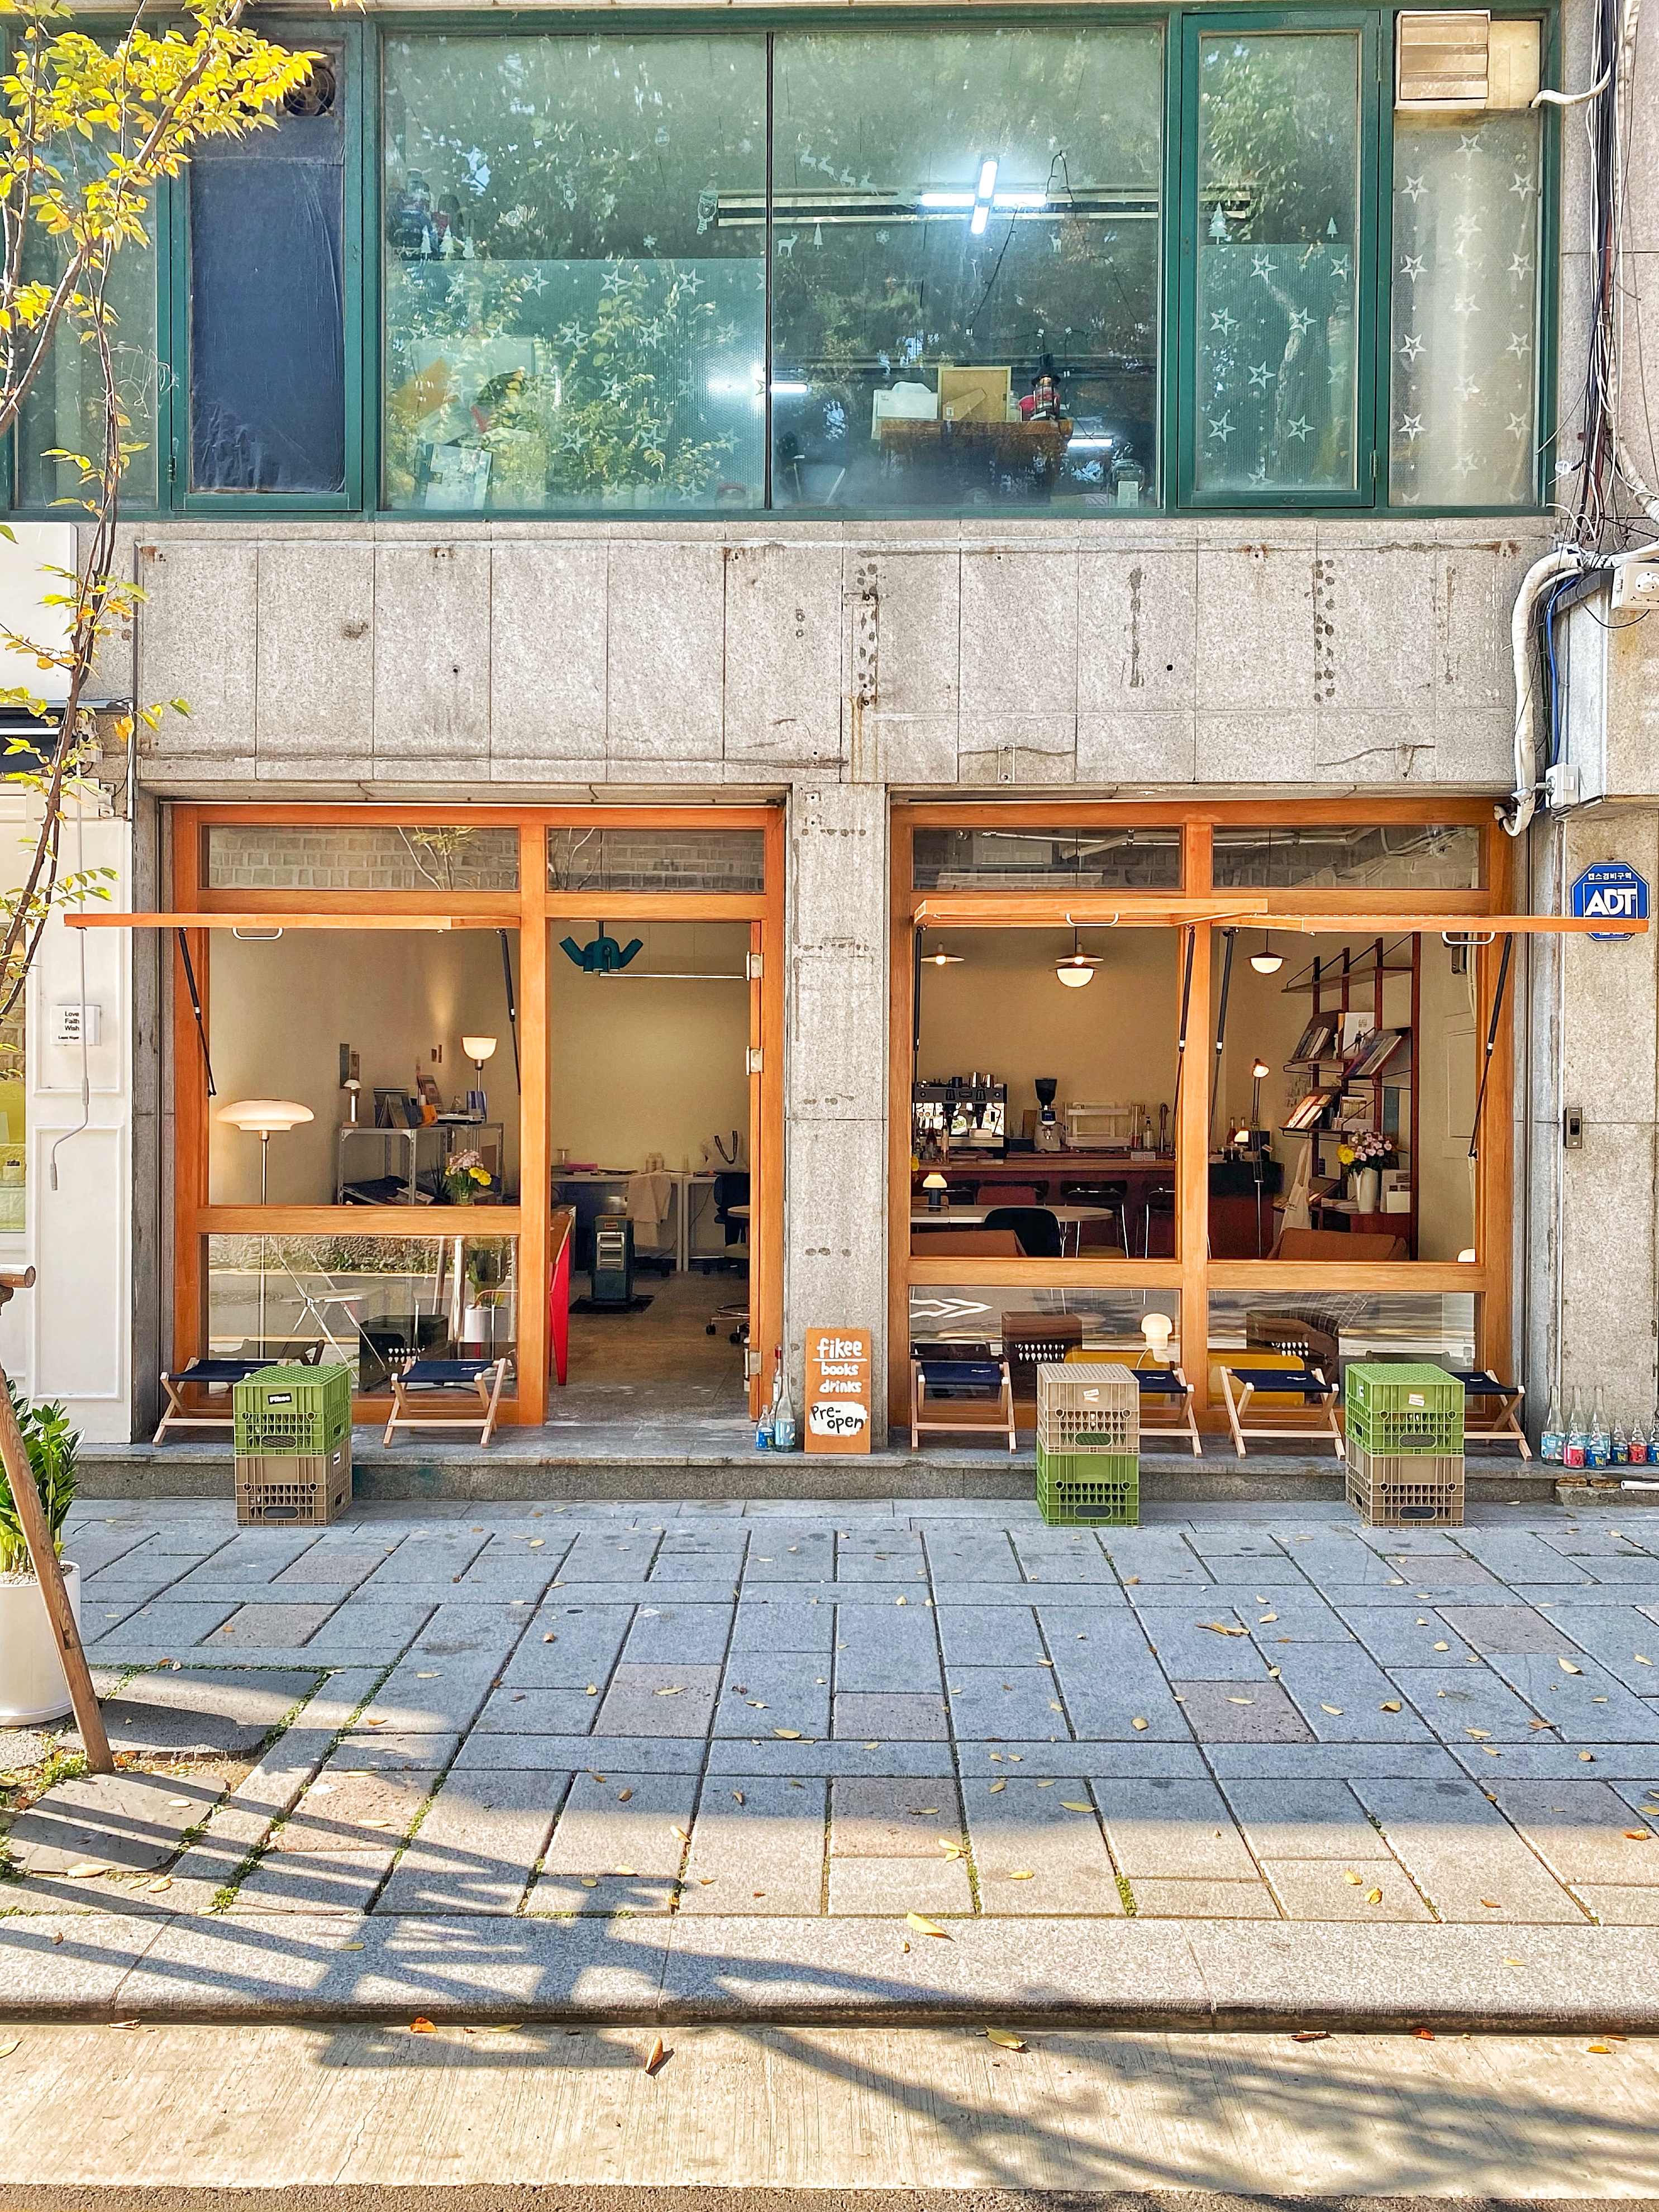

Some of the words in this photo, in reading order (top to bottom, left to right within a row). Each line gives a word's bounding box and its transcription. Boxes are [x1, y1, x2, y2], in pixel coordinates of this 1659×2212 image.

[1585, 888, 1637, 916] ADT
[817, 1337, 862, 1358] fikee
[821, 1362, 859, 1376] books
[819, 1380, 862, 1393] drinks
[811, 1405, 841, 1420] Pre-
[827, 1416, 864, 1434] open
